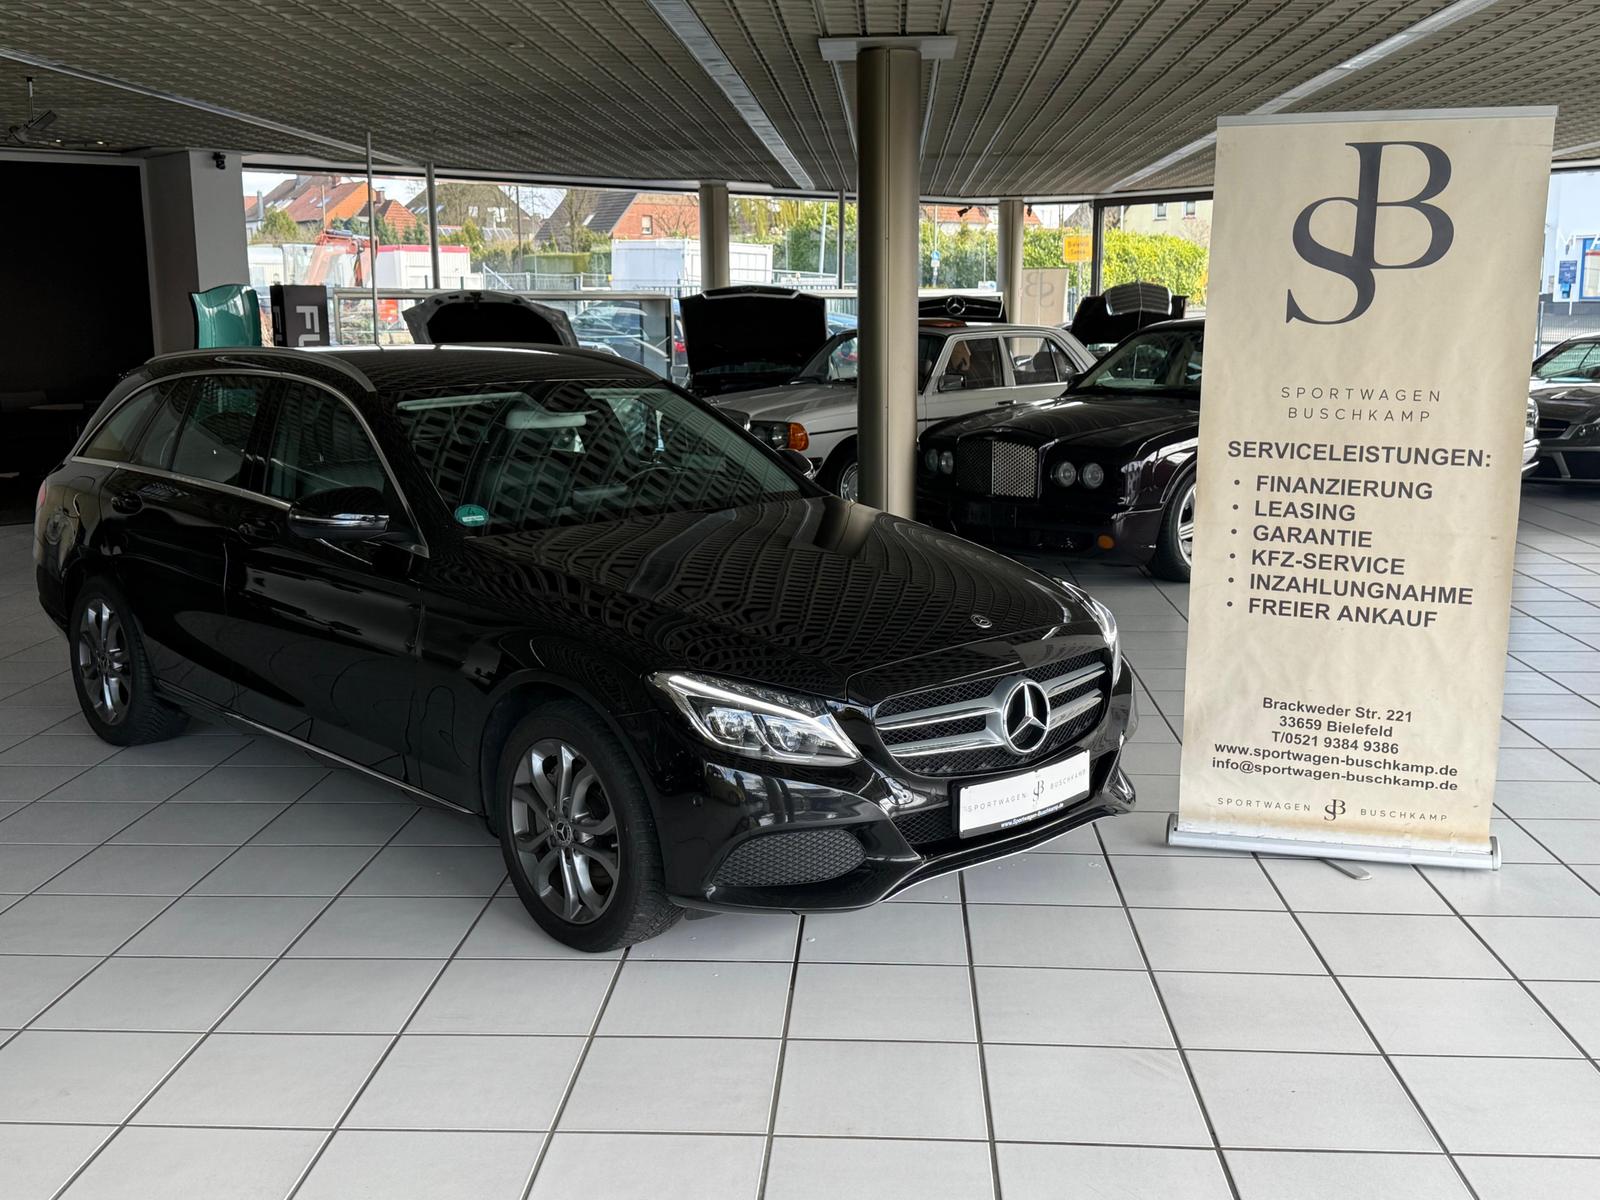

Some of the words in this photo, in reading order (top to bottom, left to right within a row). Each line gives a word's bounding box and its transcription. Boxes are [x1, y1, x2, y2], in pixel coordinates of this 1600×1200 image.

[1281, 386, 1441, 402] SPORTWAGEN
[1288, 407, 1431, 423] BUSCHKAMP
[1228, 440, 1491, 467] SERVICELEISTUNGEN:
[1256, 475, 1433, 500] FINANZIERUNG
[1255, 500, 1356, 521] LEASING
[1253, 525, 1372, 548] GARANTIE
[1251, 549, 1405, 575] KFZ-SERVICE
[1250, 573, 1473, 605] INZAHLUNGNAHME
[1249, 598, 1330, 620] FREIER
[1337, 605, 1438, 628] ANKAUF
[1262, 697, 1351, 717] Brackweder
[1355, 706, 1381, 720] Str.
[1386, 709, 1413, 723] 221
[1279, 715, 1322, 731] 33659
[1327, 720, 1393, 738] Bielefeld
[1272, 731, 1318, 747] T/0521
[1324, 736, 1359, 751] 9384
[1363, 741, 1399, 755] 9386
[1214, 743, 1458, 777] www.sportwagen-buschkamp.de
[1212, 757, 1458, 791] info@sportwagen-buschkamp.de
[967, 791, 1027, 813] SPORTWAGEN
[1050, 769, 1087, 789] BUSCHKAMP
[1217, 797, 1311, 812] SPORTWAGEN
[1360, 808, 1448, 822] BUSCHKAMP
